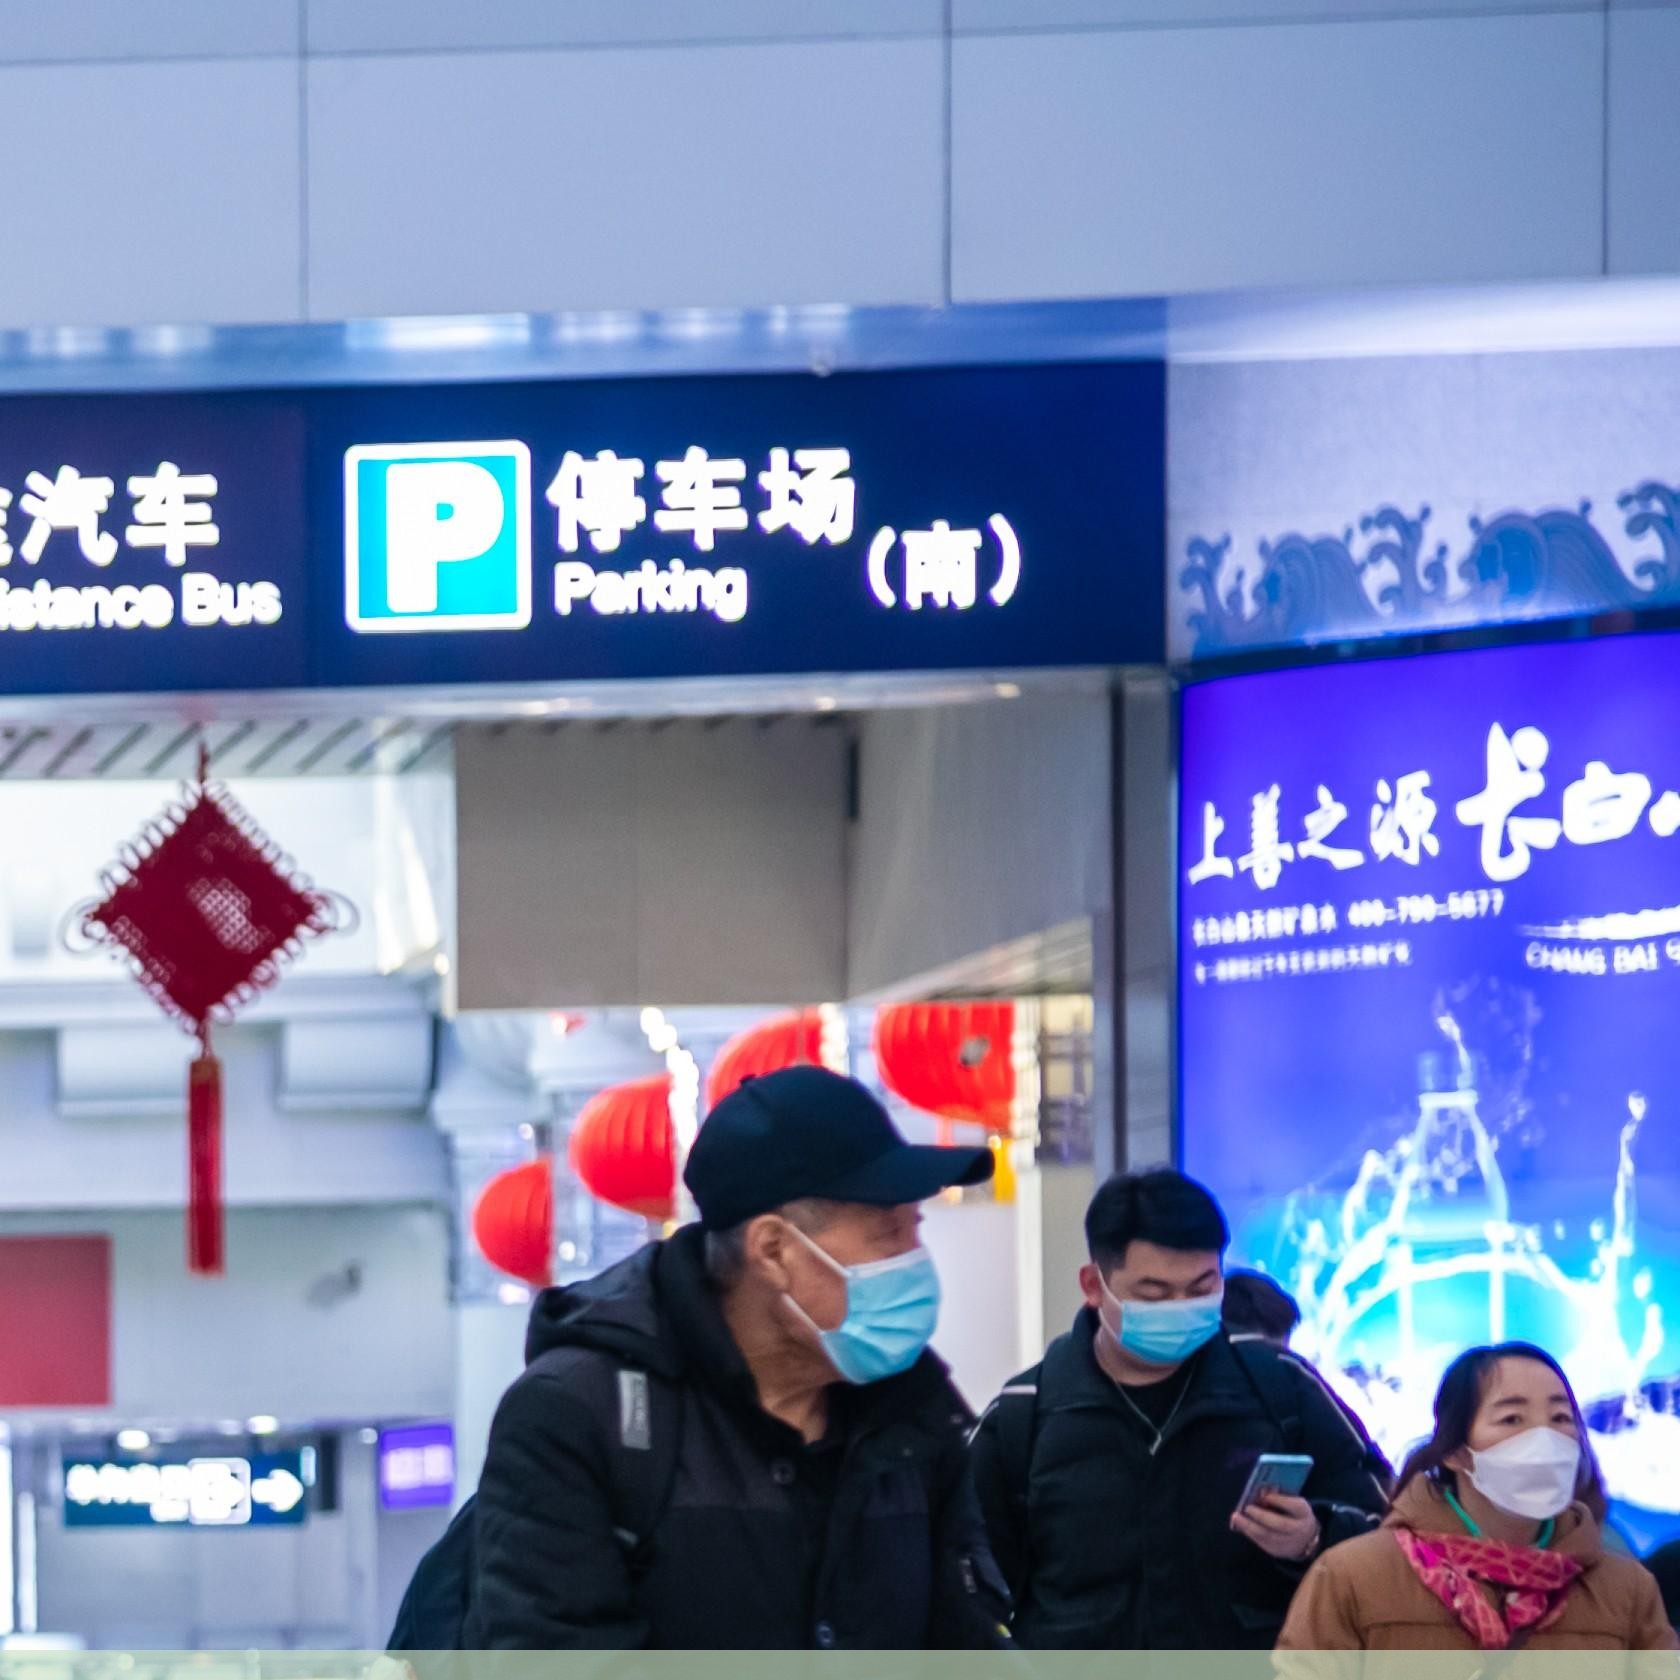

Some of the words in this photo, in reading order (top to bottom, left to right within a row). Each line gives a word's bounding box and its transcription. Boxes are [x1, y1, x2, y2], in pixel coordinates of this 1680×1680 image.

[545, 445, 855, 552] 停车场
[867, 513, 1021, 610] （南）
[181, 572, 283, 626] Bus
[553, 558, 749, 622] Parking
